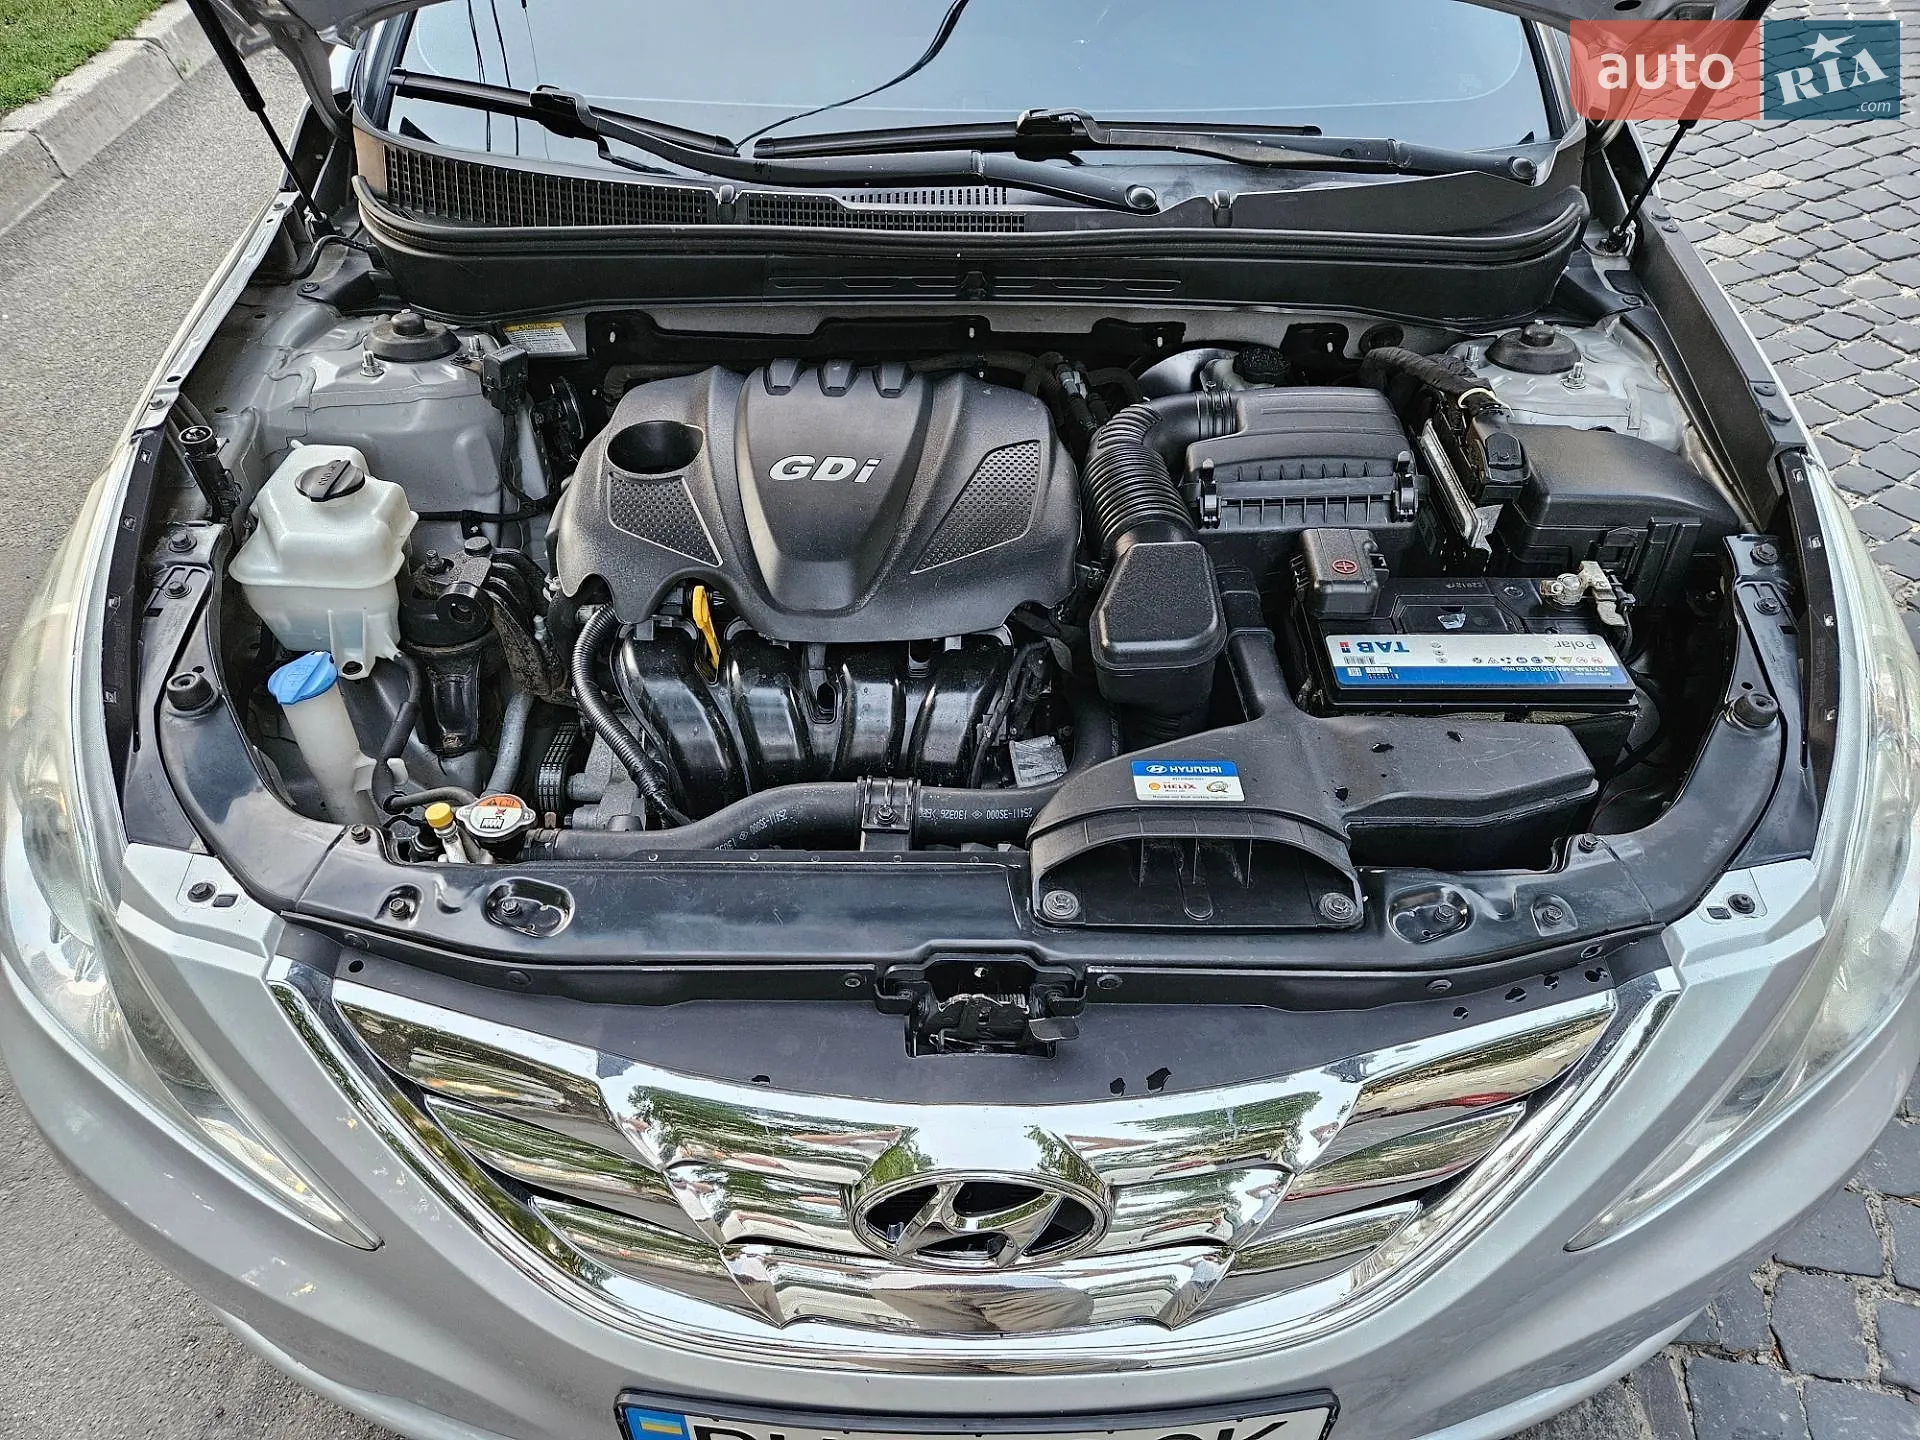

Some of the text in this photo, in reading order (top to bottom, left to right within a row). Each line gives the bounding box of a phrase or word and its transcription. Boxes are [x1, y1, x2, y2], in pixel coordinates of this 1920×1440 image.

[768, 454, 882, 483] GDi
[1356, 641, 1410, 654] TAB
[1554, 640, 1597, 650] Polar
[1169, 766, 1222, 774] HYUNDAI
